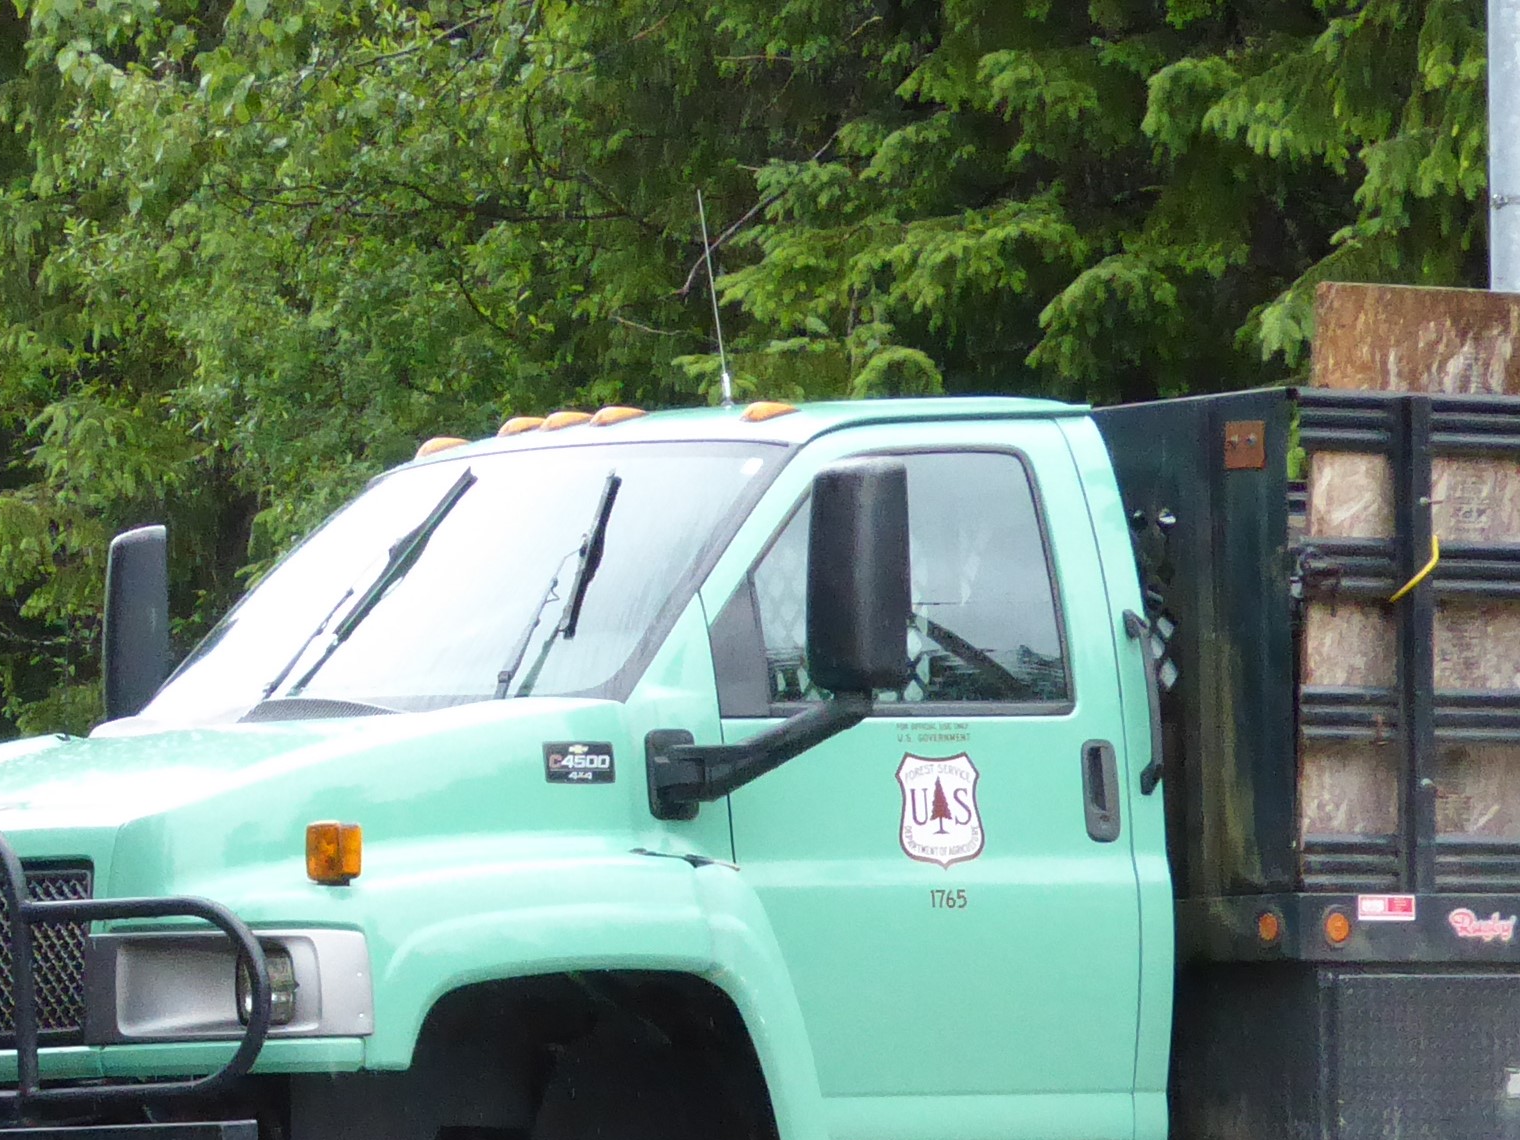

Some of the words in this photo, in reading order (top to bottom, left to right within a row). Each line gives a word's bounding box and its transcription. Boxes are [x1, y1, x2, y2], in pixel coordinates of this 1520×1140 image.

[918, 732, 971, 742] GOVERNMENT
[548, 754, 610, 769] C4500
[904, 763, 934, 784] FOREST
[937, 763, 971, 783] SERVICE
[930, 889, 968, 909] 1765
[1449, 908, 1517, 942] Rugby
